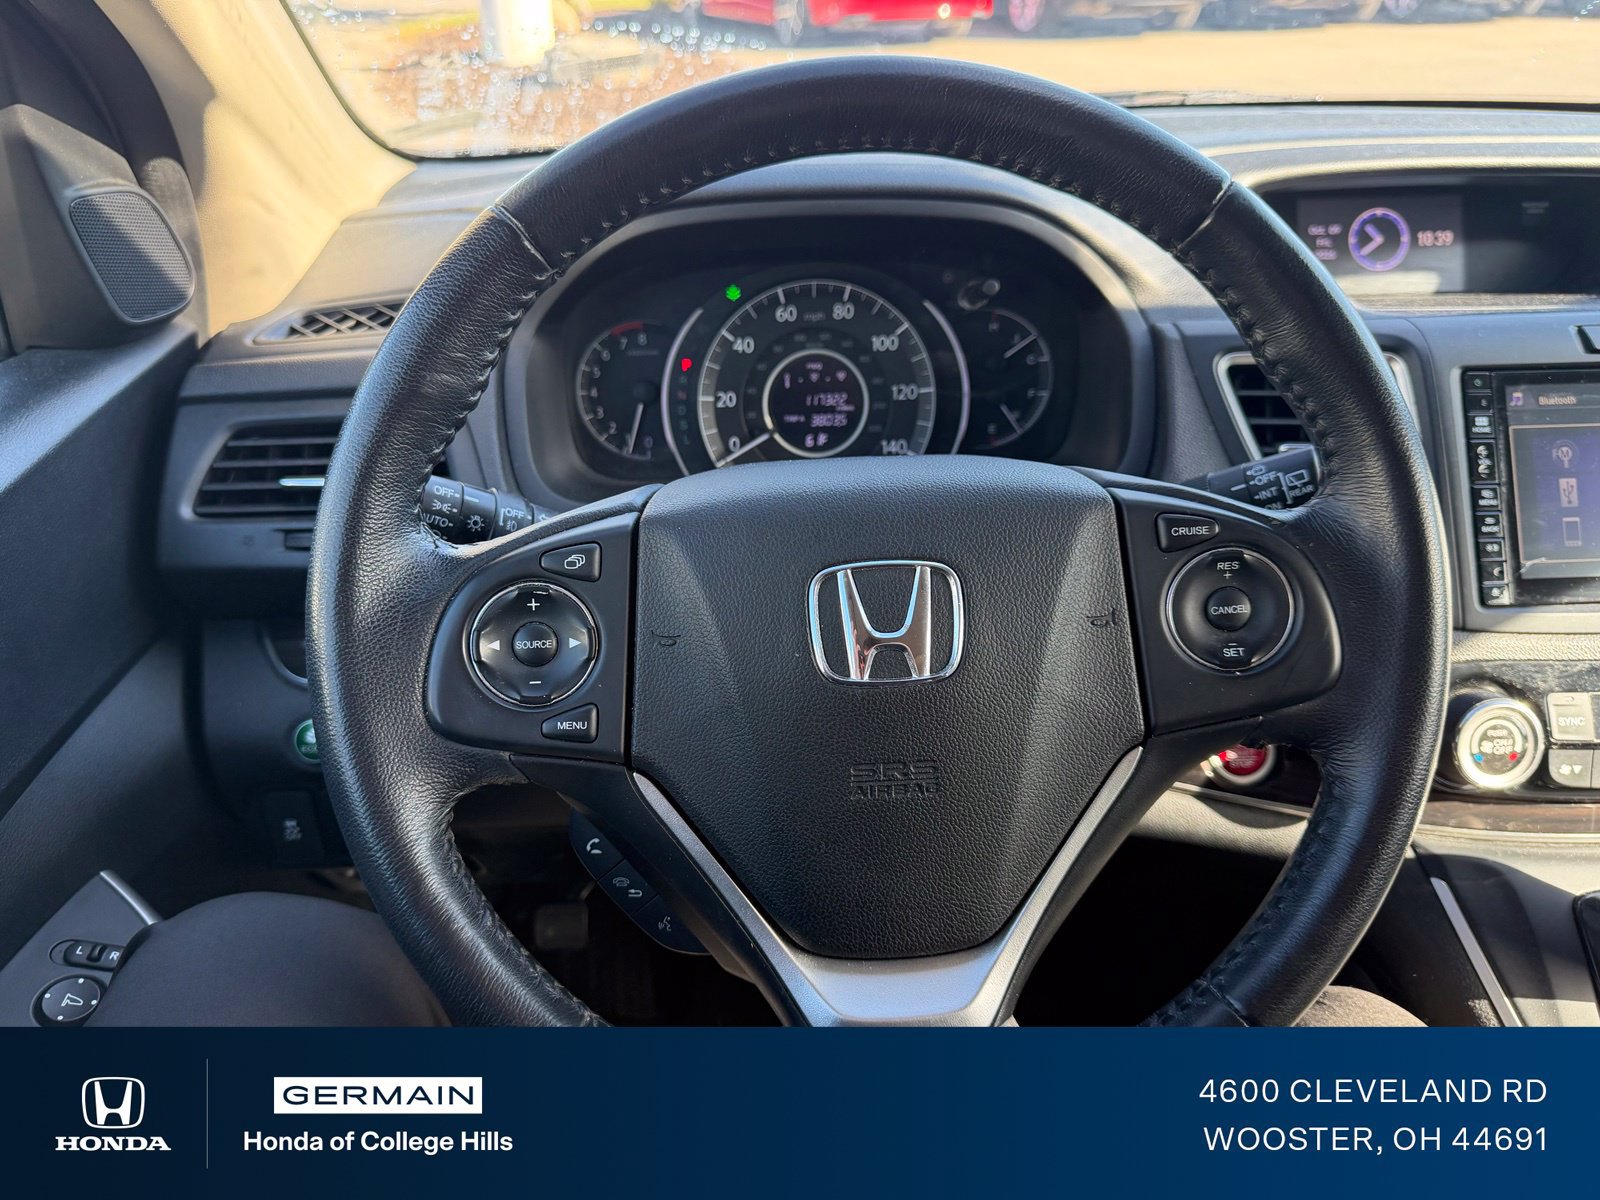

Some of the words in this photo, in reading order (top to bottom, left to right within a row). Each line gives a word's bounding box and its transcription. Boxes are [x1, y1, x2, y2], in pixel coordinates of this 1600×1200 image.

[774, 304, 797, 322] 60
[832, 302, 855, 320] 80
[732, 336, 755, 354] 40
[871, 334, 899, 352] 100
[891, 384, 919, 400] 120
[716, 391, 737, 408] 20
[728, 436, 740, 452] 0
[1254, 471, 1277, 486] OFF
[434, 485, 456, 499] OFF
[1258, 486, 1277, 500] INT
[1288, 485, 1315, 497] REAR
[505, 508, 525, 519] OFF
[1171, 526, 1210, 536] CRUISE
[1217, 561, 1239, 570] RES
[1211, 605, 1249, 615] CANCEL
[516, 640, 553, 649] SOURCE
[1223, 648, 1245, 657] SET
[557, 721, 588, 730] MENU
[1558, 717, 1585, 726] SYNC
[75, 946, 83, 954] L
[109, 951, 120, 960] R
